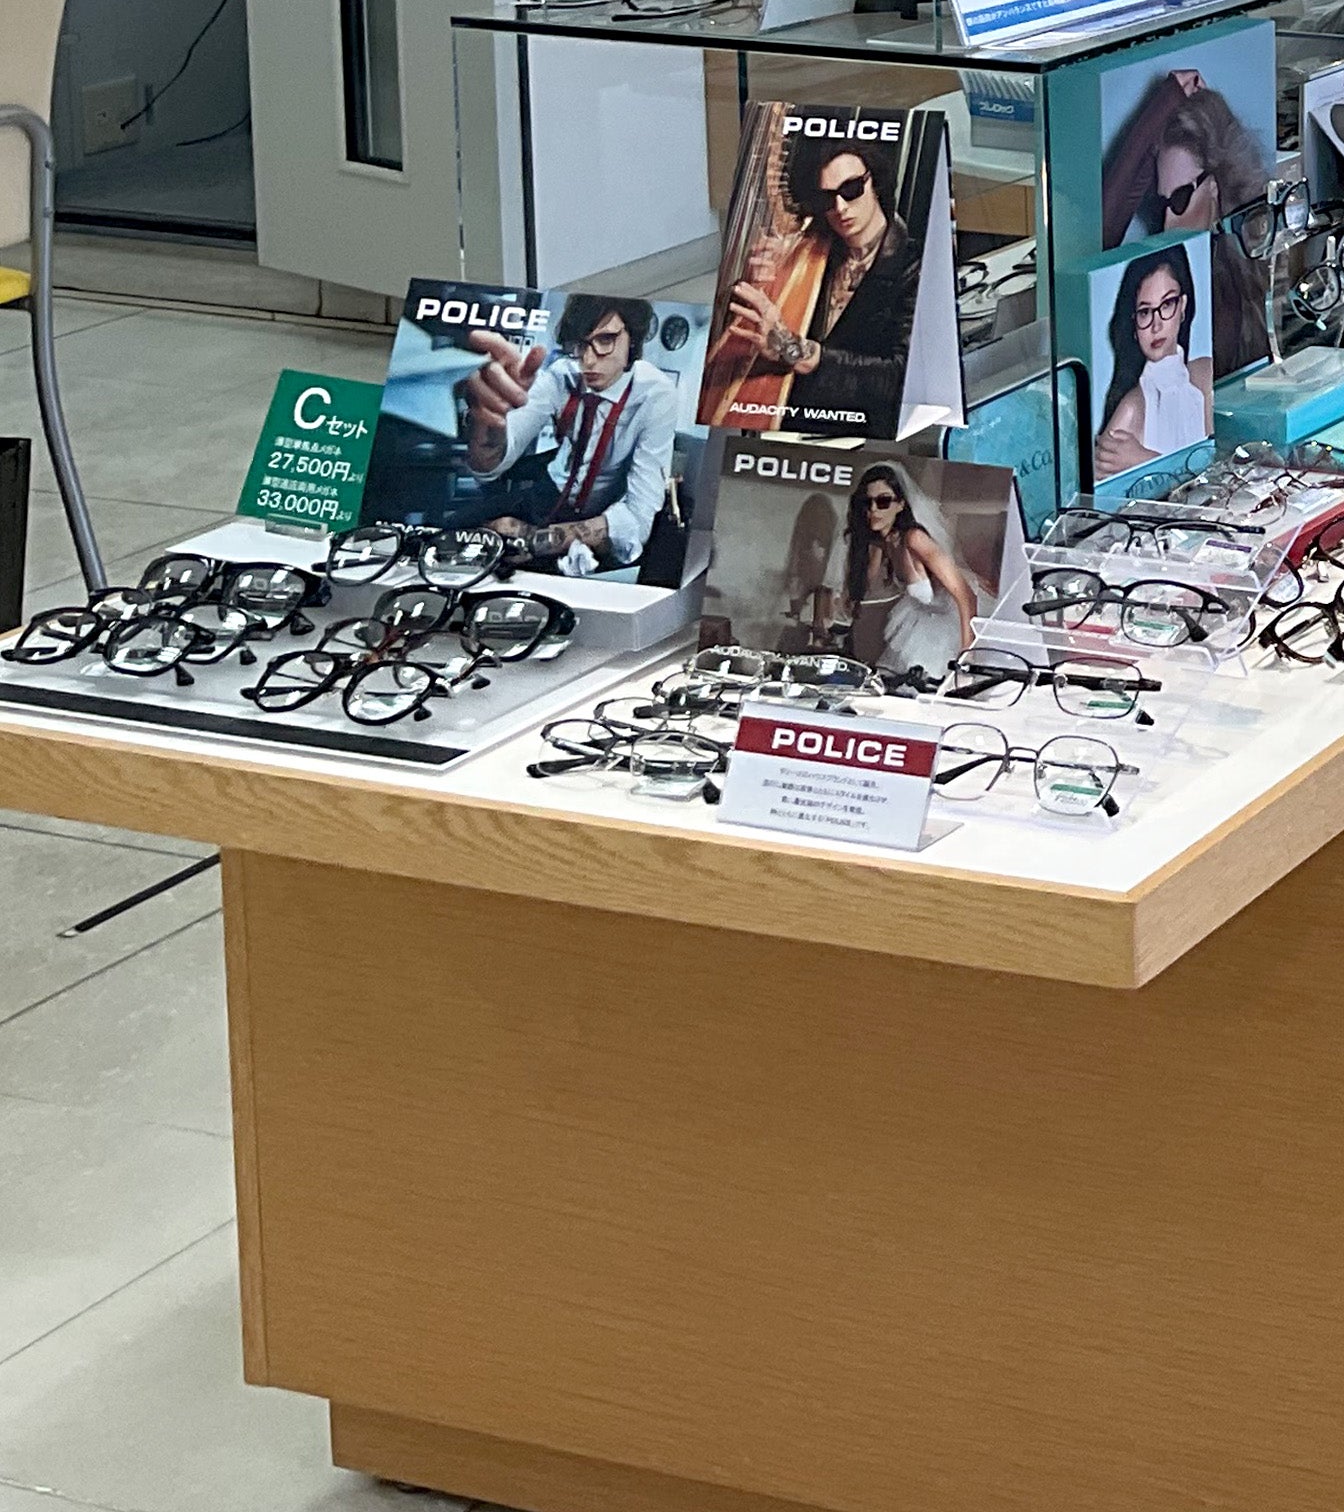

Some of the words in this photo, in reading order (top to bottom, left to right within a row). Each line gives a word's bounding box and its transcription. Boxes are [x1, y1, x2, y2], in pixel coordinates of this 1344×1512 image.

[782, 116, 902, 142] POLICE
[415, 297, 551, 333] POLICE
[294, 386, 369, 439] Cセット
[728, 401, 800, 418] AUDACITY
[734, 453, 854, 486] POLICE
[771, 727, 908, 768] POLICE
